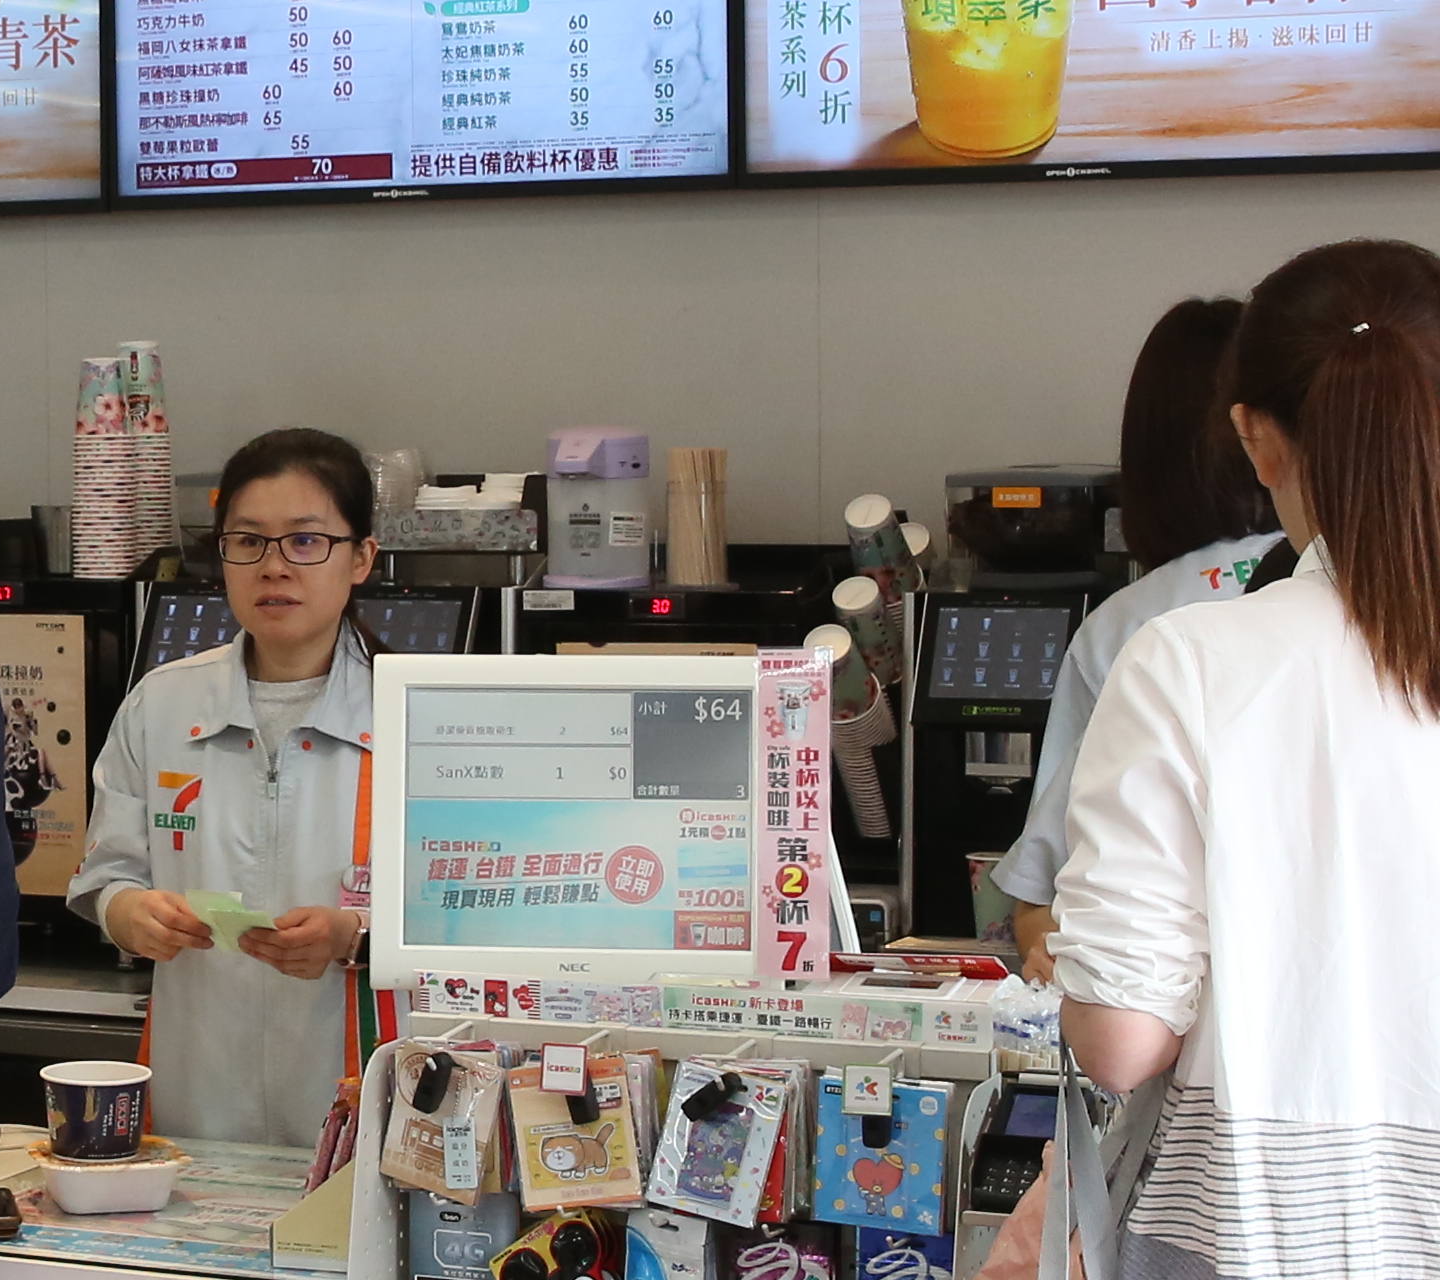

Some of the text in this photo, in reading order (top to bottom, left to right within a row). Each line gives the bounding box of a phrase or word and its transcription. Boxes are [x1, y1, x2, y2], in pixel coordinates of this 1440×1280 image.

[138, 6, 308, 30] 巧克力牛奶 50
[441, 15, 588, 36] 鴛鴦奶茶 60
[138, 36, 247, 55] 福岡八女抹茶拿鐵
[441, 42, 525, 60] 太妃焦糖奶茶
[333, 56, 352, 71] 50
[442, 59, 673, 84] 珍珠純奶茶 55
[442, 91, 511, 108] 經典純奶茶
[442, 107, 674, 131] 經典紅茶 35
[290, 134, 310, 150] 55
[140, 164, 209, 181] 特大杯拿鐵
[411, 147, 620, 179] 提供自備飲料杯優惠
[638, 697, 743, 723] 小計 $64
[610, 726, 629, 736] $64
[436, 765, 627, 780] SanX點數 1 $0
[736, 785, 745, 798] 3
[767, 752, 790, 828] 杯裝咖啡
[795, 747, 820, 832] 中杯以上
[522, 852, 603, 877] 全面通行
[618, 855, 656, 878] 立即
[614, 875, 651, 897] 使用
[441, 883, 600, 911] 現買現用 輕鬆賺點
[559, 963, 590, 973] NEC
[748, 996, 804, 1012] 新卡登場
